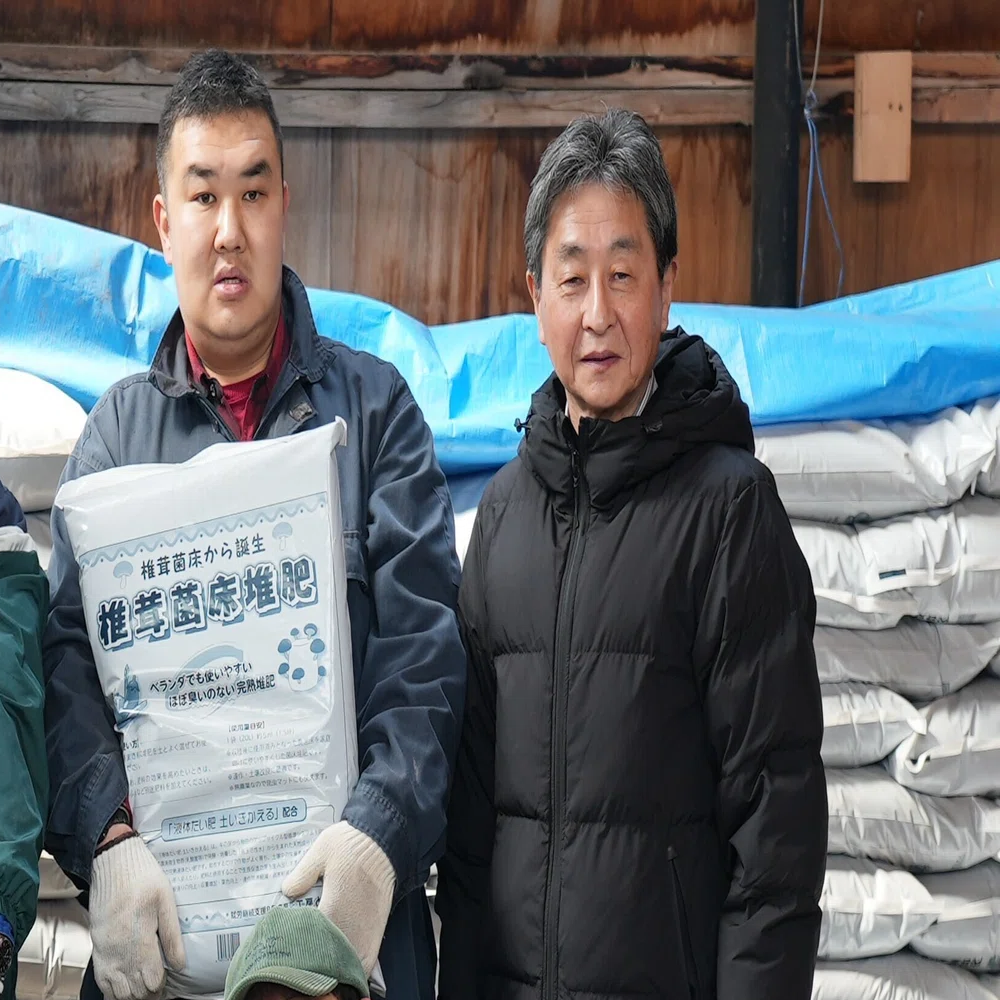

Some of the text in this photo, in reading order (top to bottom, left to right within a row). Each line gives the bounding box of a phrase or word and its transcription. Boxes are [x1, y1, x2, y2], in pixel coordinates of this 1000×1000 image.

[141, 533, 266, 580] 椎茸菌床から誕生
[97, 554, 318, 652] 椎茸菌床堆肥
[150, 662, 253, 693] ベランダでも使いやすい
